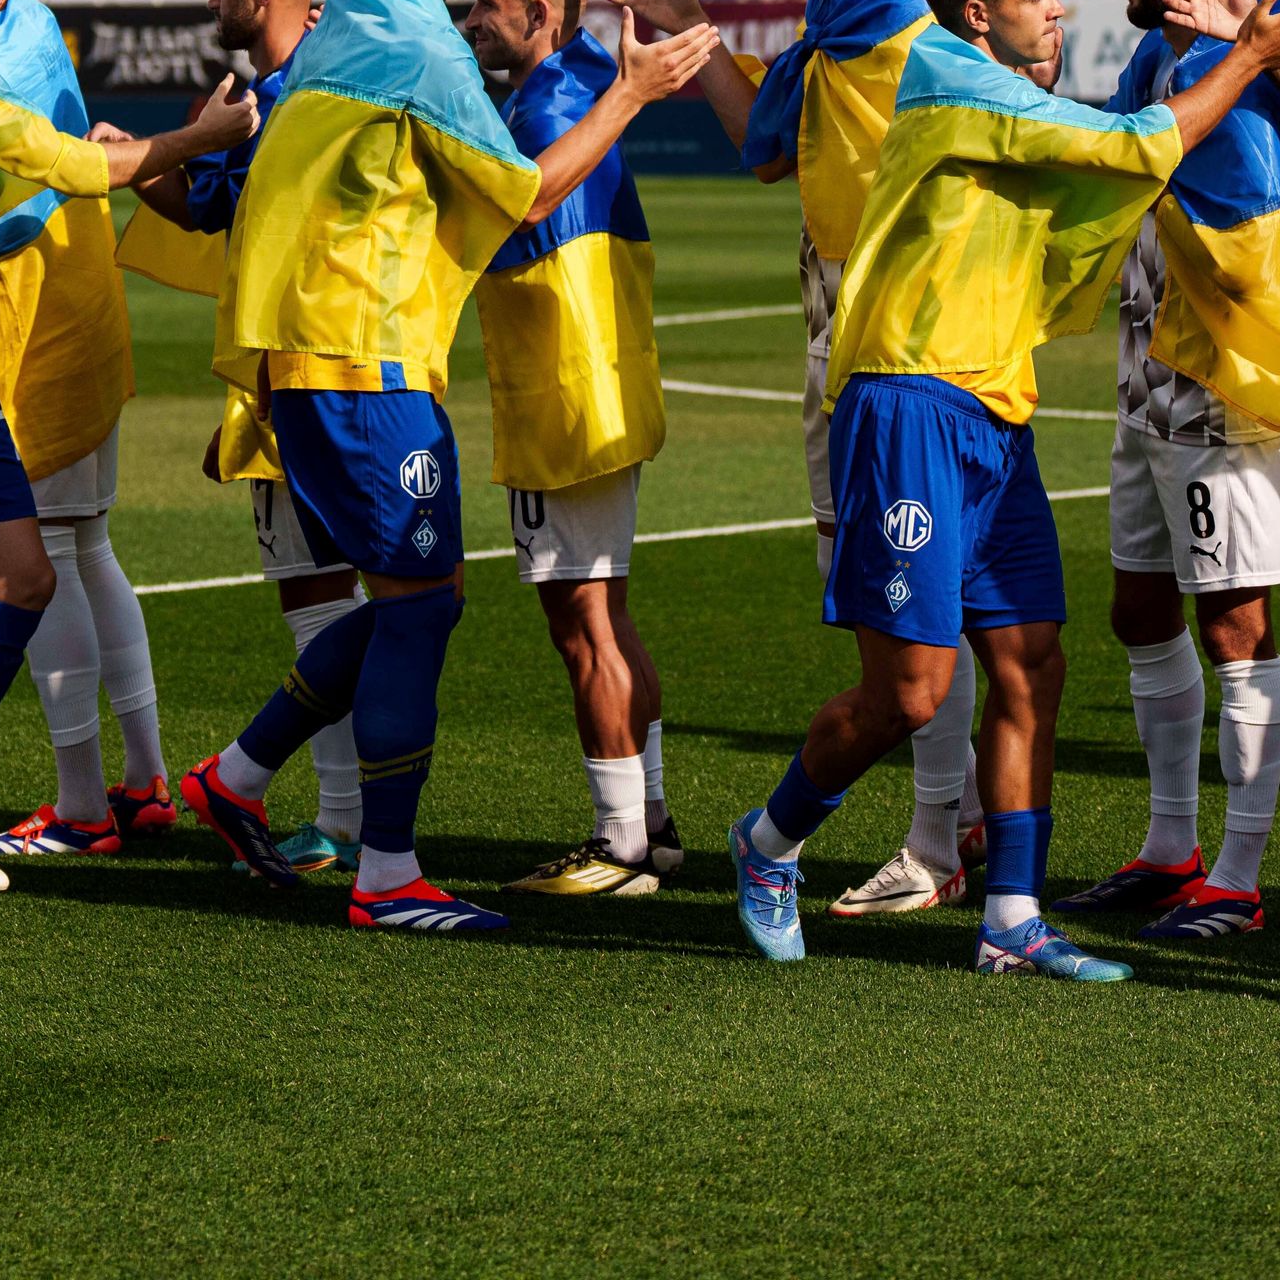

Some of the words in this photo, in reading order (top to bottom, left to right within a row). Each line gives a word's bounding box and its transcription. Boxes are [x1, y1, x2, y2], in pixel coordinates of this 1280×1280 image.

[402, 454, 439, 496] MG
[886, 503, 928, 548] MG
[1186, 481, 1216, 539] 8
